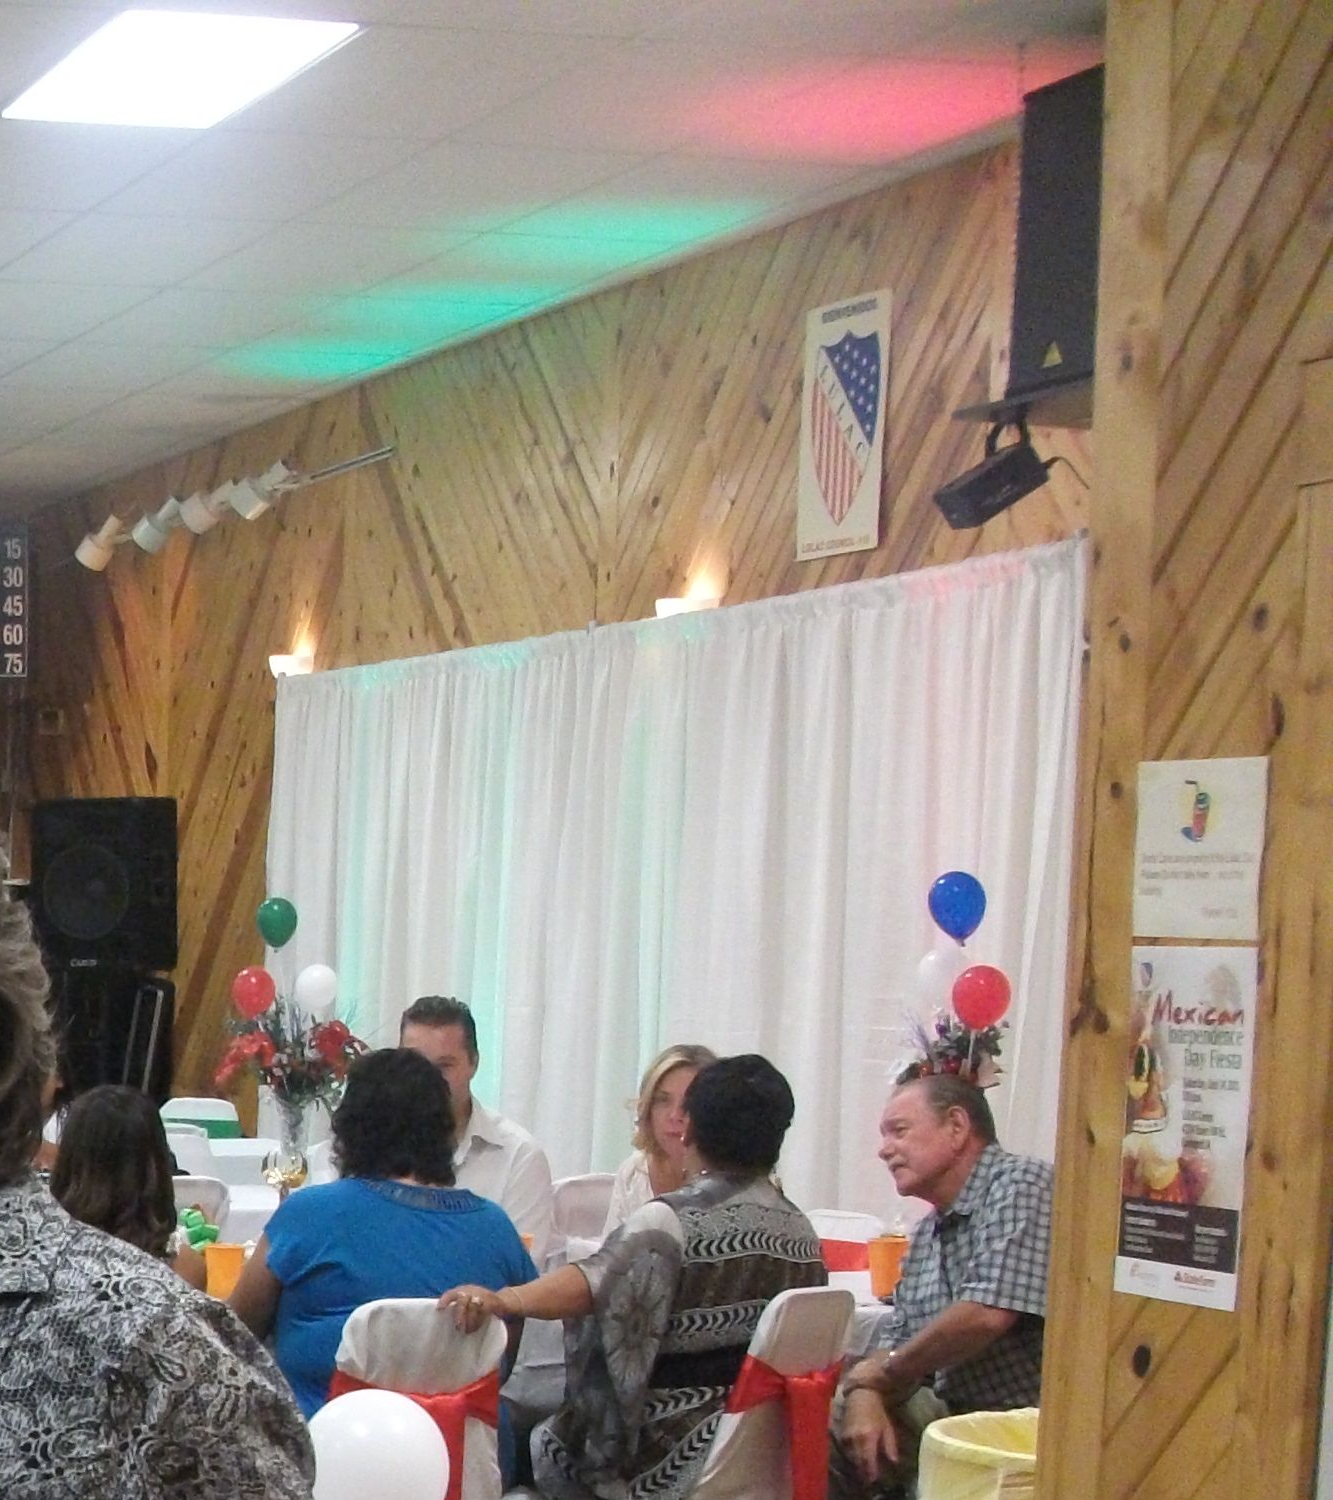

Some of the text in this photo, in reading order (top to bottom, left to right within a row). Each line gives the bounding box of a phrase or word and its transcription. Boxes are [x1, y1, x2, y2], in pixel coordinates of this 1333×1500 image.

[4, 538, 21, 560] 15
[3, 566, 23, 588] 30
[3, 595, 23, 616] 45
[3, 624, 23, 645] 60
[4, 653, 23, 674] 75
[1151, 989, 1245, 1026] Mexican
[1184, 1048, 1242, 1071] Day Fiesta
